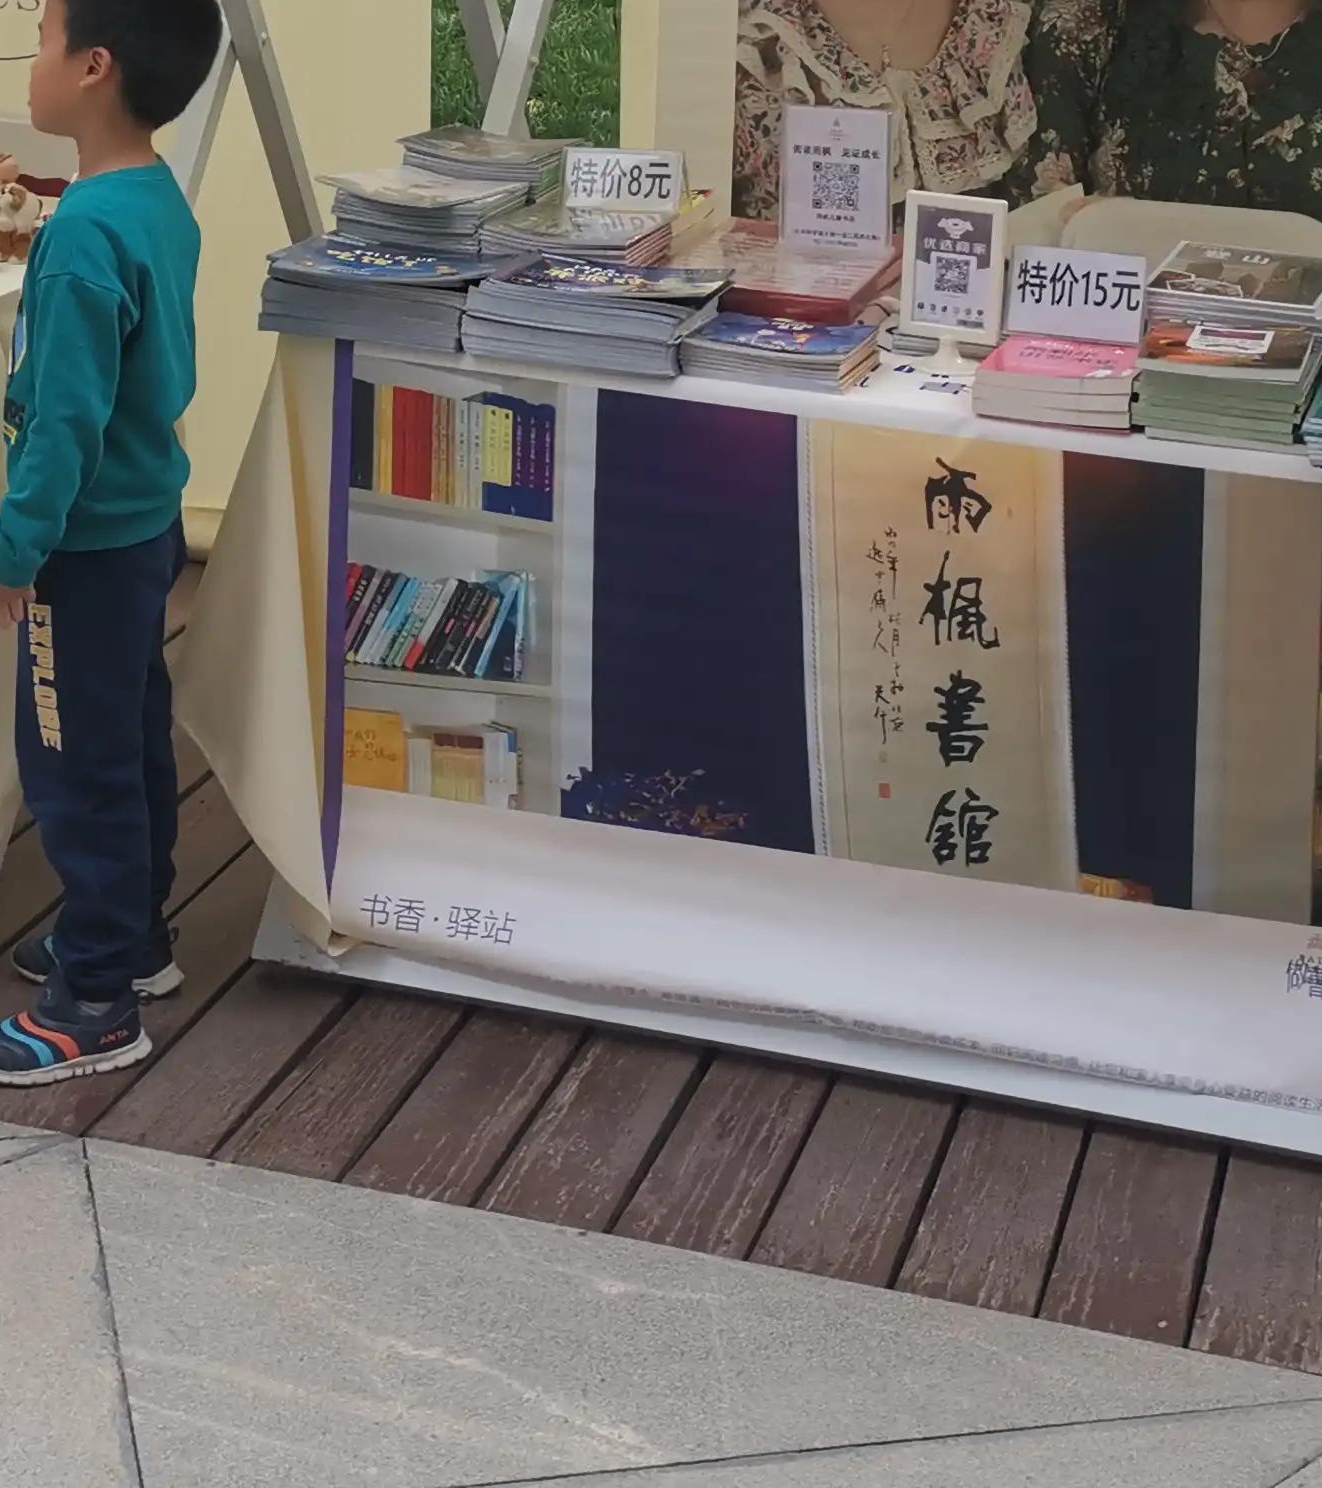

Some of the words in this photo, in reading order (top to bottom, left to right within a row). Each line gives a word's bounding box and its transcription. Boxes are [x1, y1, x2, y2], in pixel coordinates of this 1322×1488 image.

[571, 156, 672, 201] 特价8元
[1017, 258, 1142, 313] 特价15元
[27, 603, 63, 753] EXPLORE
